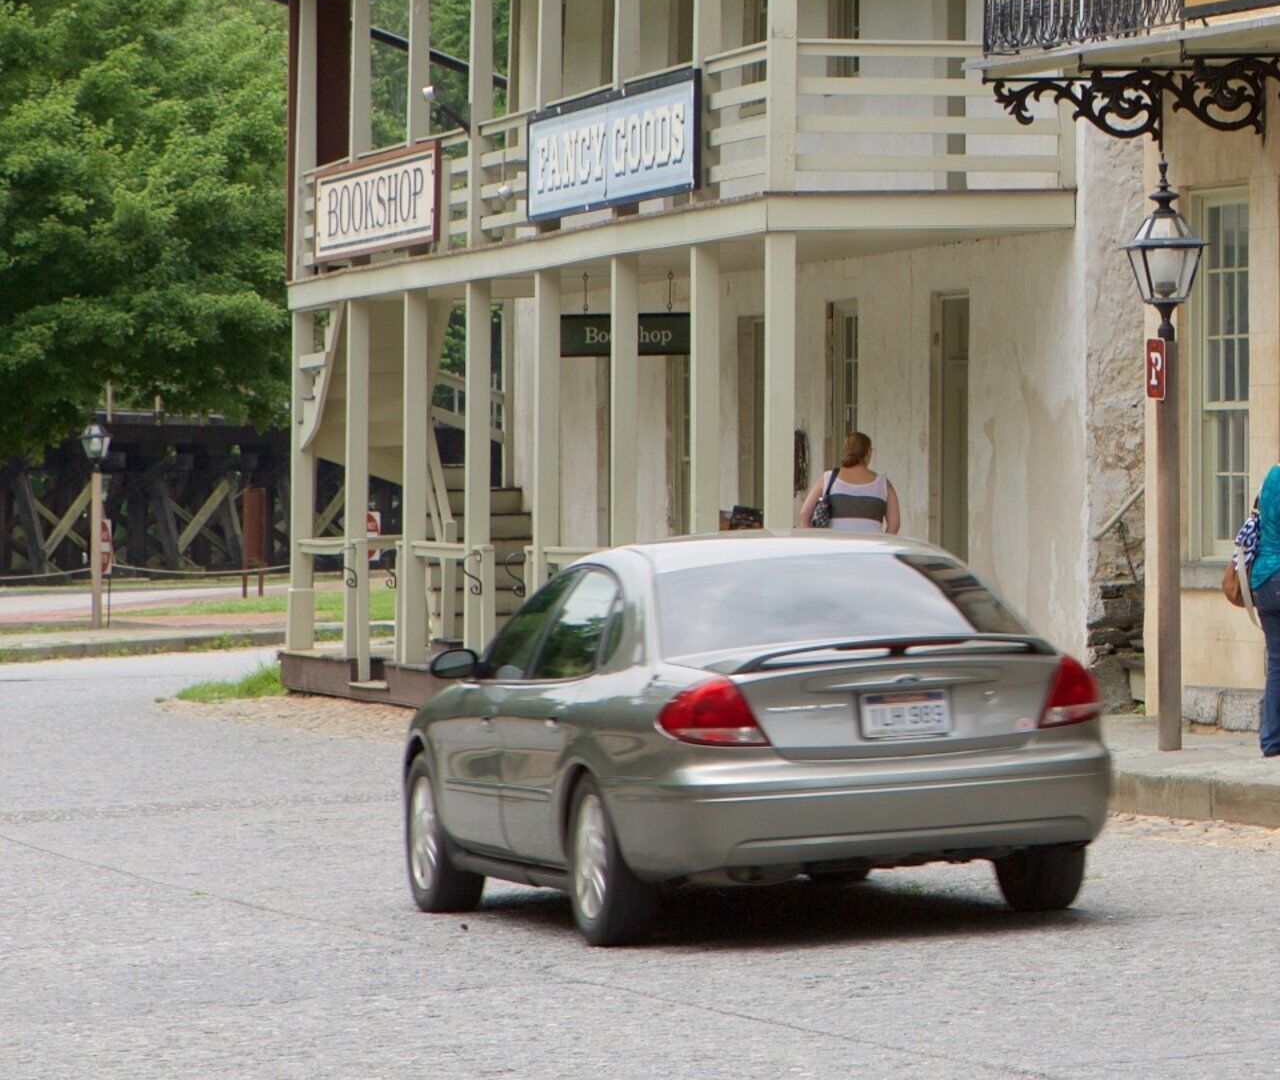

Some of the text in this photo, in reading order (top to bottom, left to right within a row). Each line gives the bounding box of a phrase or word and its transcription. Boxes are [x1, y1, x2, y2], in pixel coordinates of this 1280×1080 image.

[537, 102, 685, 194] FANCY GOODS
[327, 167, 425, 238] BOOKSHOP
[584, 326, 672, 346] Bohop
[1150, 351, 1162, 386] P
